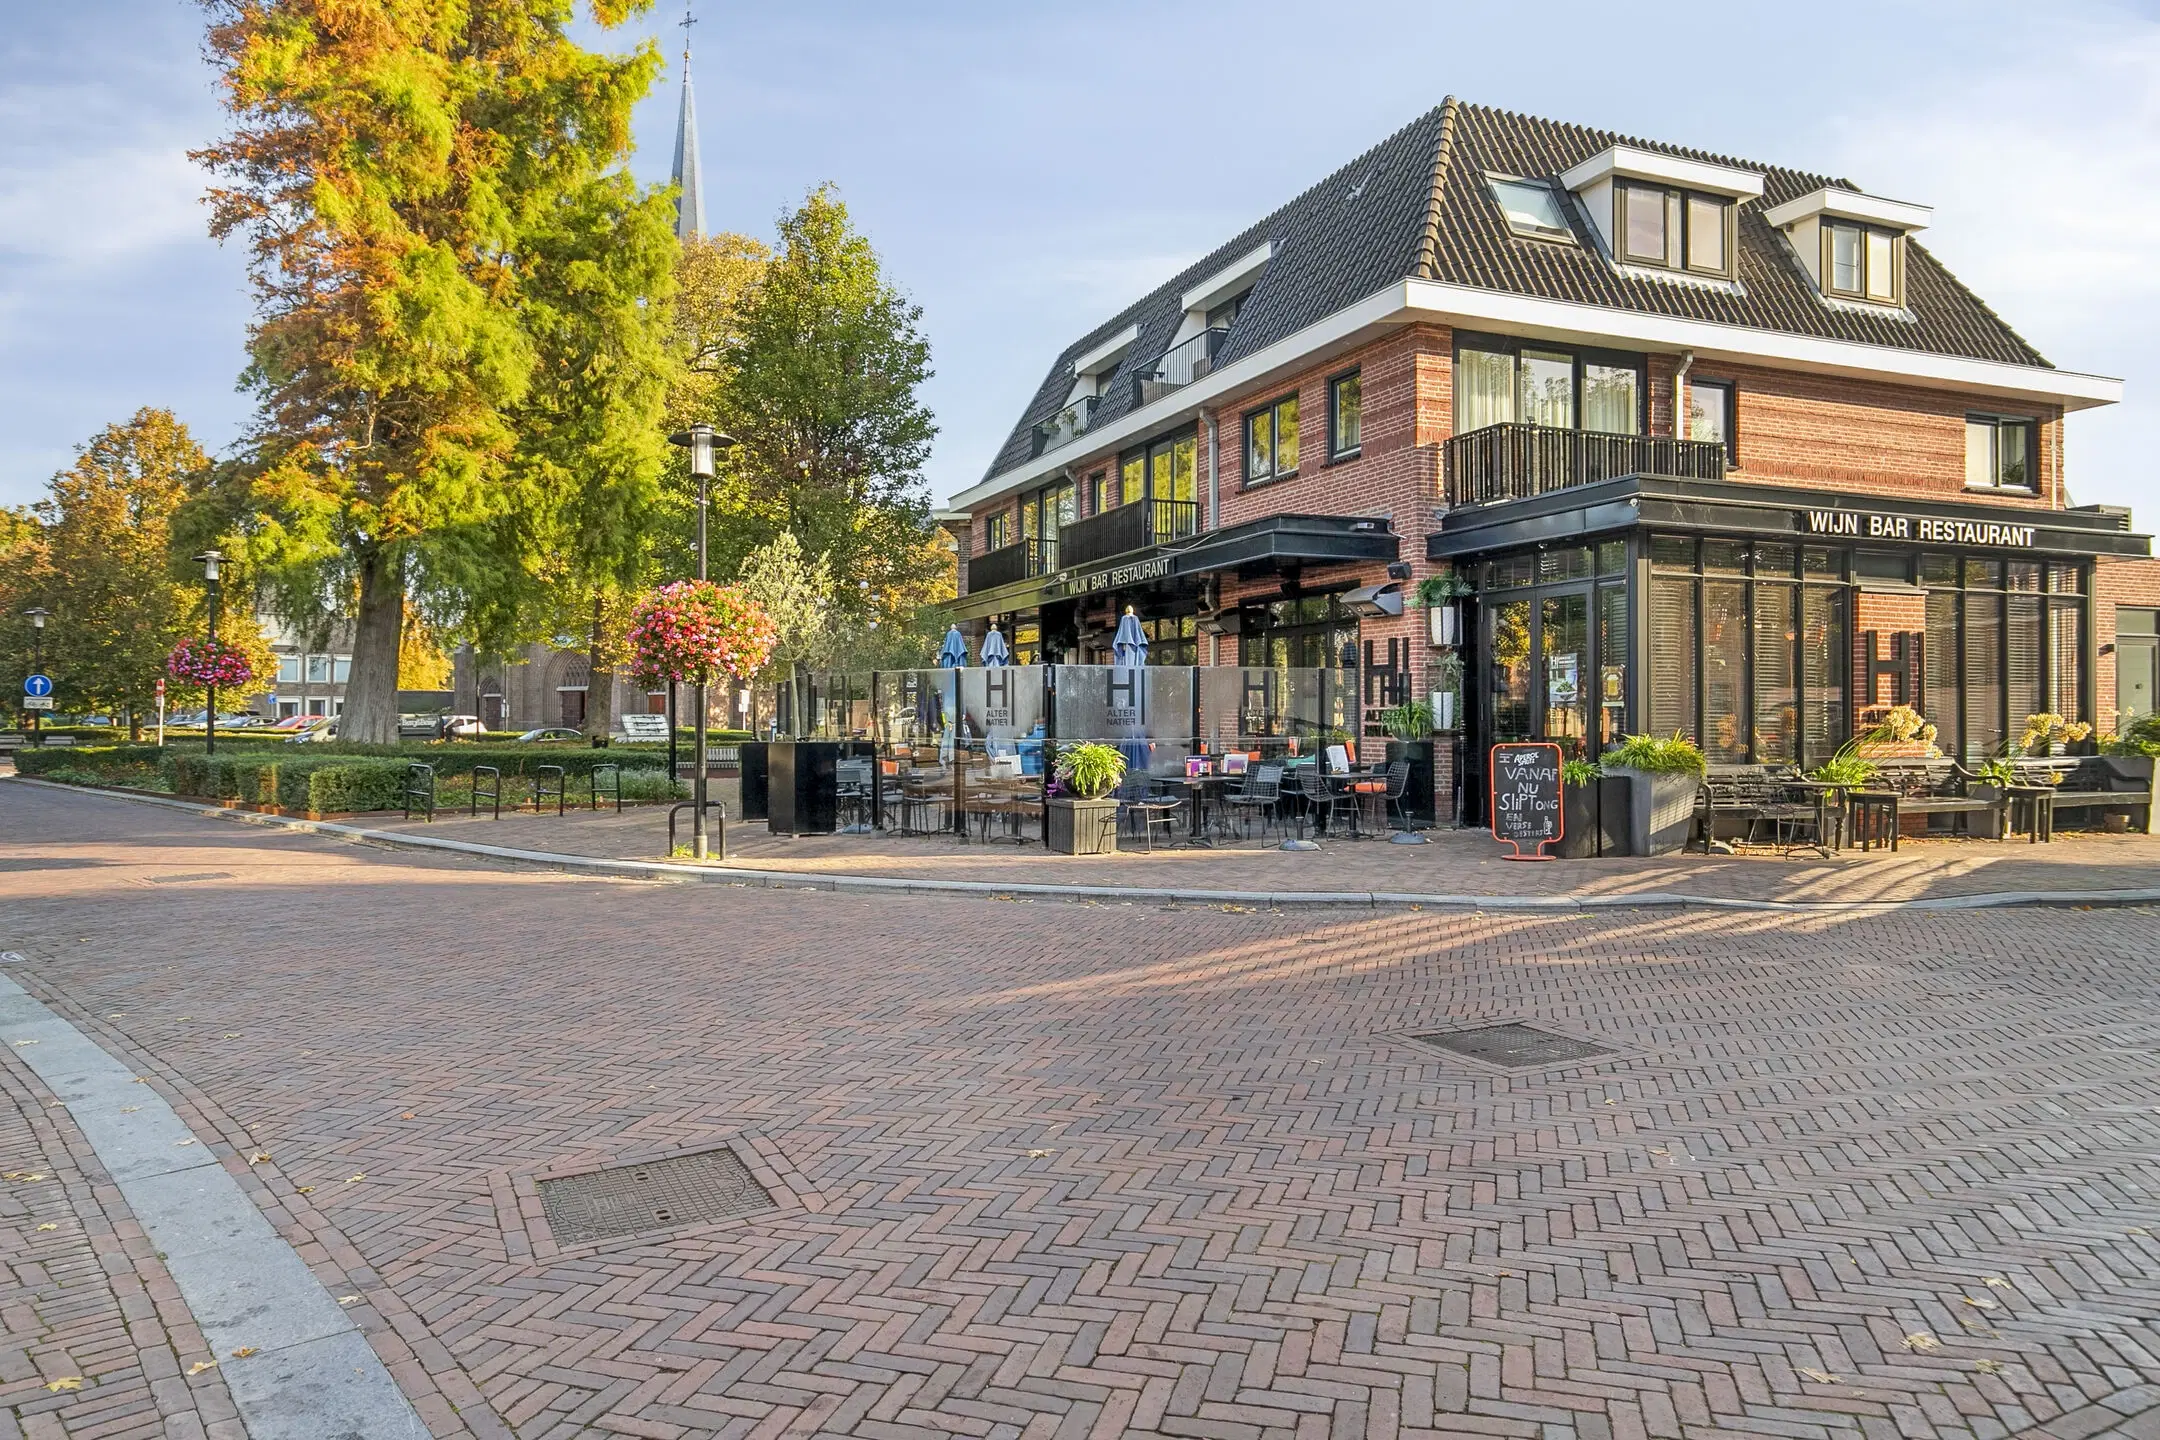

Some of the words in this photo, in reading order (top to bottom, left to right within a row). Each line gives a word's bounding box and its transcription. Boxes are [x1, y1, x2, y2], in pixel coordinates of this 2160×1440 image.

[1809, 511, 1858, 535] WIJN
[1869, 516, 1908, 538] BAR
[1919, 519, 2035, 547] RESTAURANT
[1069, 580, 1088, 595] WIJN
[1091, 573, 1108, 590] BAR
[1112, 559, 1170, 586] RESTAURANT
[986, 709, 1008, 718] ALTER
[1107, 709, 1136, 717] ALTER
[1505, 767, 1558, 782] VANAF
[1517, 782, 1539, 794] NU
[1506, 812, 1522, 822] EN
[1505, 821, 1532, 830] VERSE
